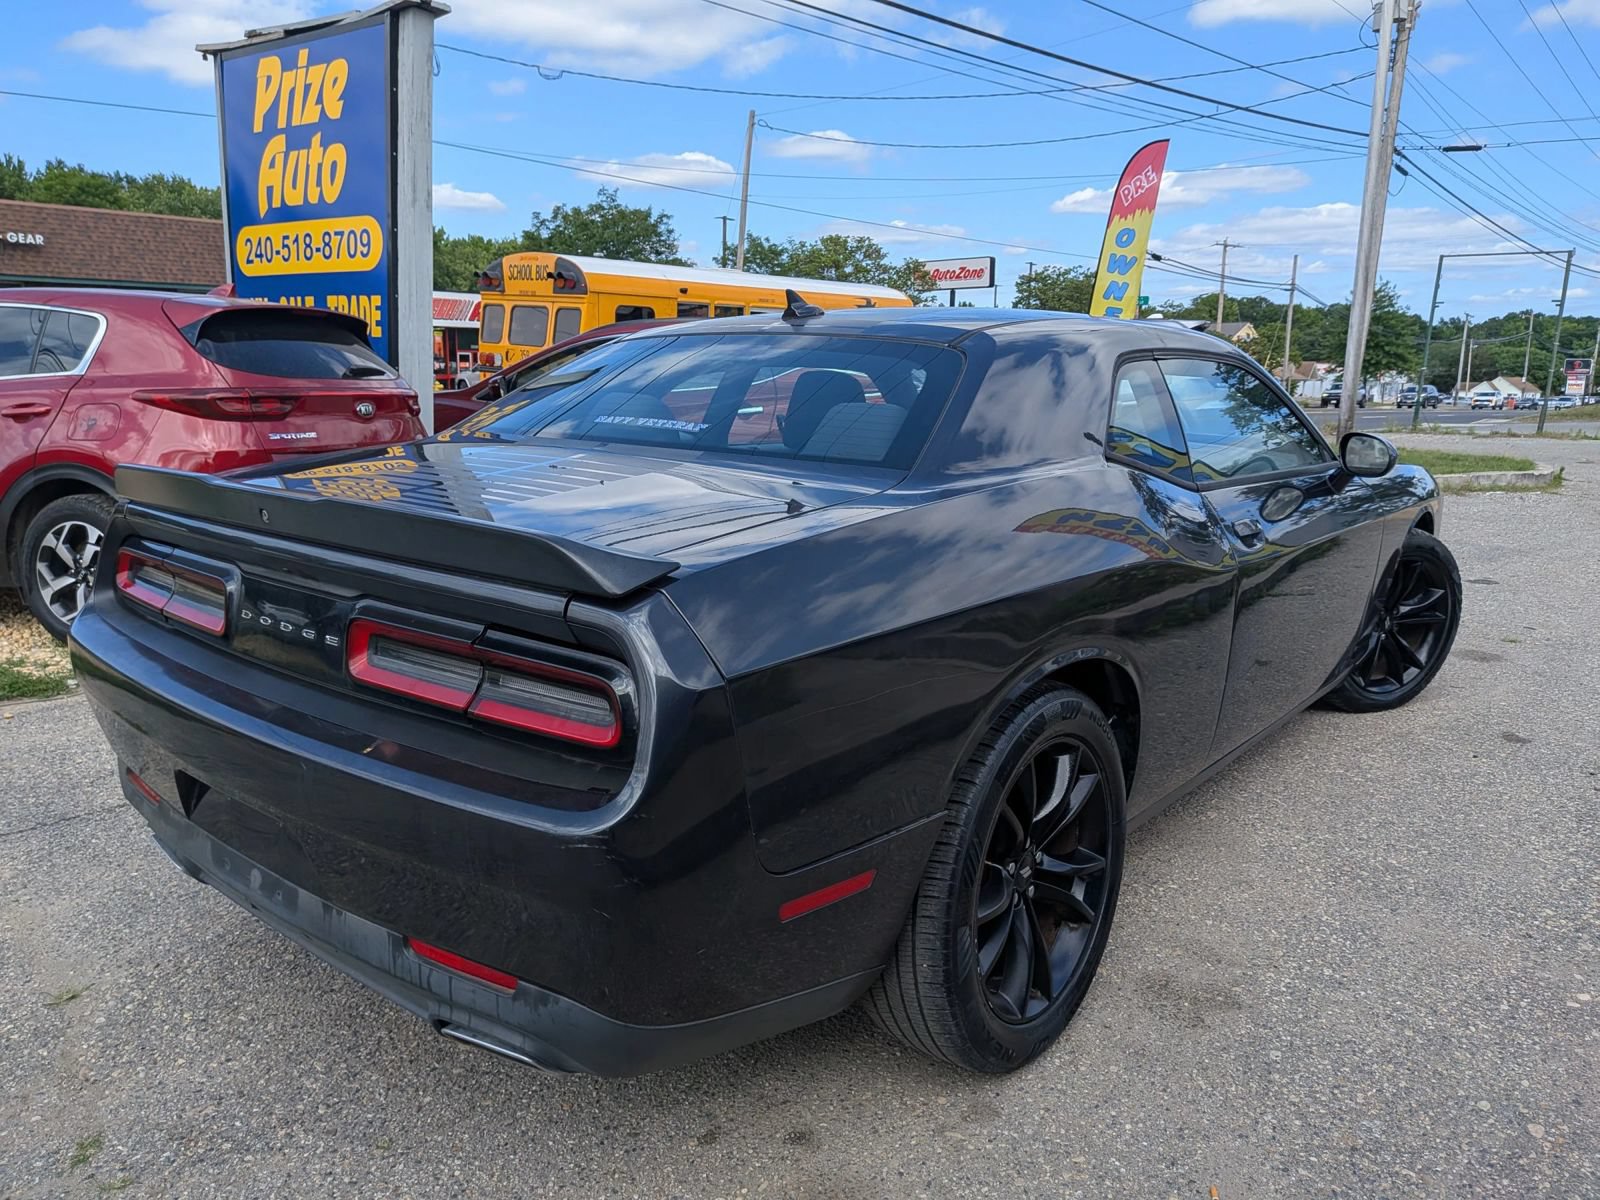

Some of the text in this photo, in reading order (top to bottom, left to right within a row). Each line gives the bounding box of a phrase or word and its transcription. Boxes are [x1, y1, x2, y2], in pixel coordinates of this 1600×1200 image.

[253, 48, 349, 134] Prize
[258, 131, 347, 219] Auto
[1120, 165, 1158, 207] PRE
[6, 231, 45, 246] GEAR
[244, 228, 371, 266] 240-518-8709
[508, 264, 550, 281] SCHOOL BUS
[930, 266, 985, 281] AutoZone
[268, 431, 318, 440] SPORTAGE
[594, 415, 712, 433] NAVY VETERAN
[241, 609, 339, 646] DODGE
